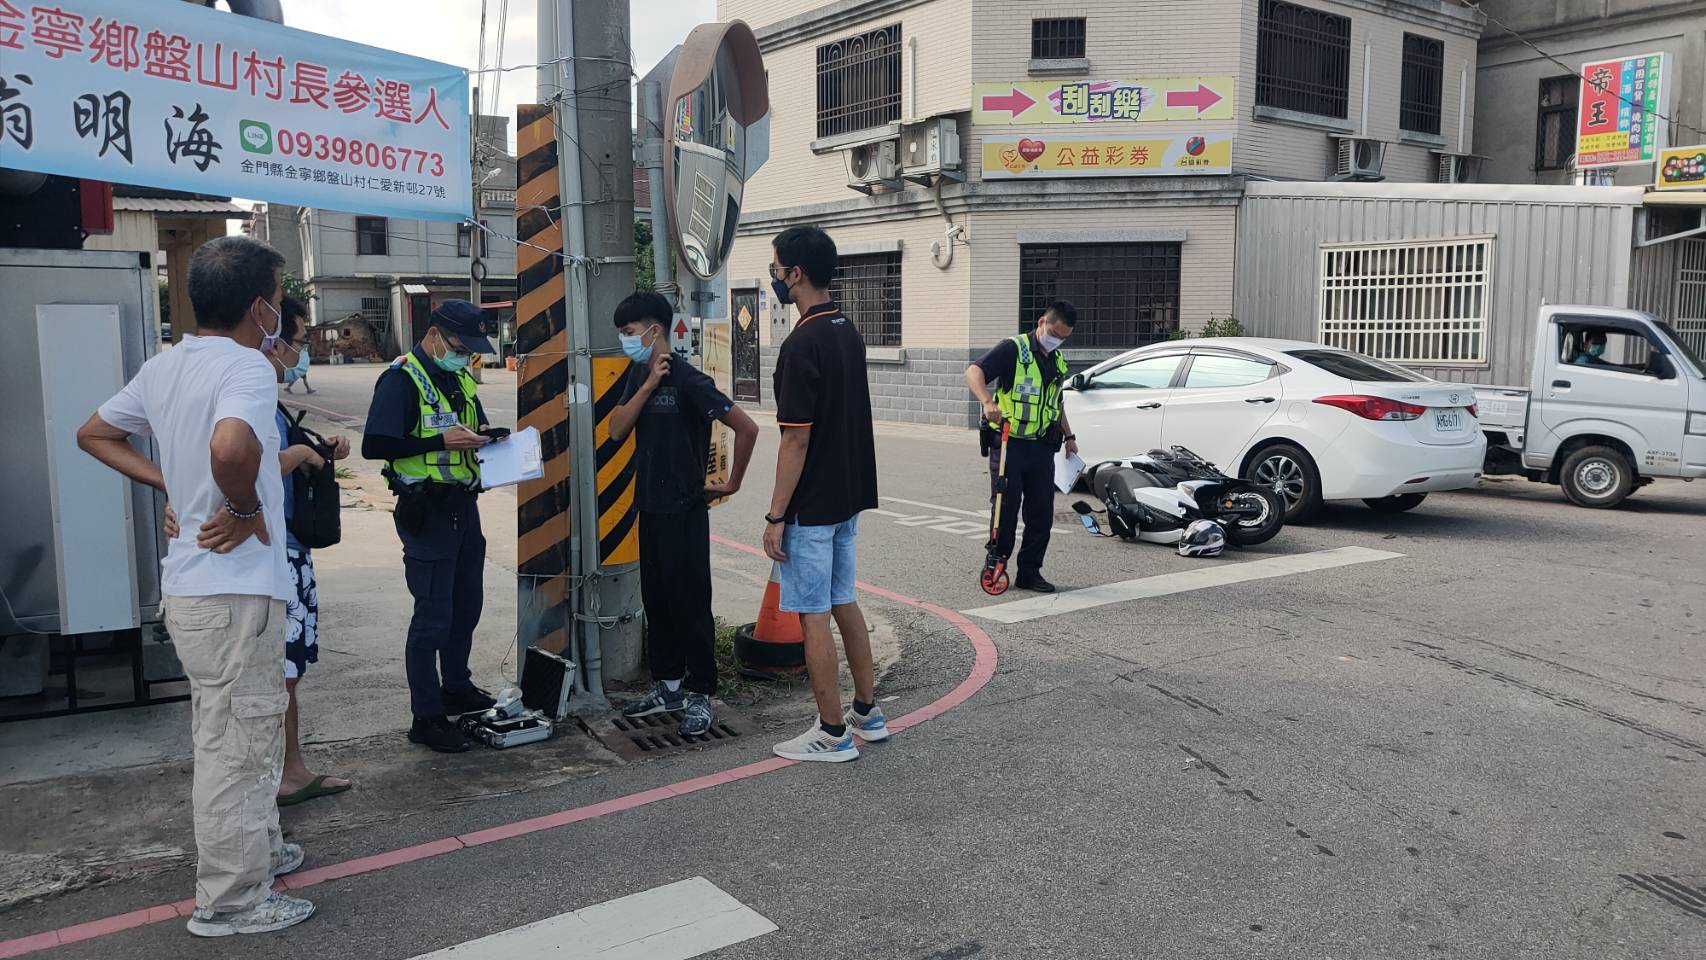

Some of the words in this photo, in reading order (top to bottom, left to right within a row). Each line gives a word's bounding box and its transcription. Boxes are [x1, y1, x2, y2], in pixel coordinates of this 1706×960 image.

[1060, 83, 1143, 121] 刮刮樂
[1588, 68, 1614, 126] 帝王
[247, 131, 265, 141] LINE
[277, 129, 444, 177] 0939806773
[1056, 146, 1149, 167] 公益彩券
